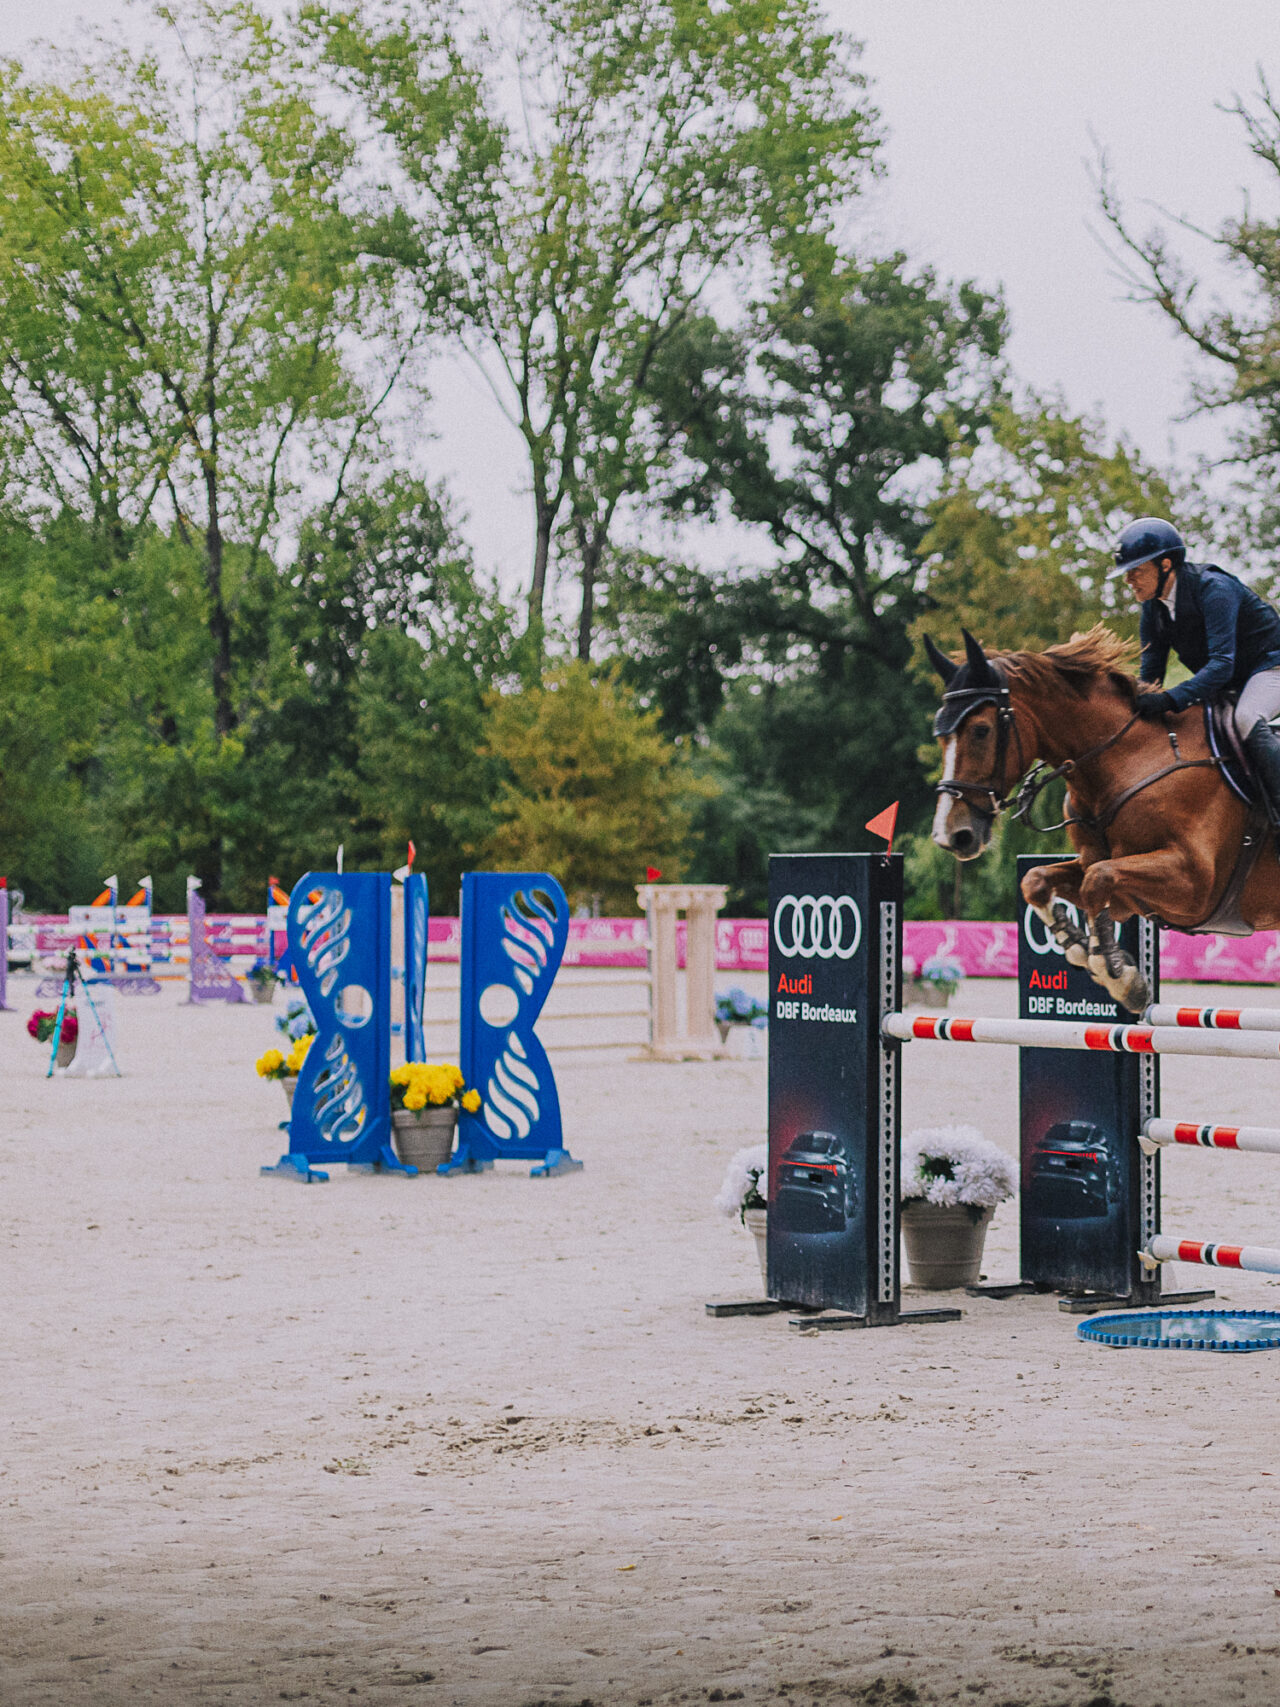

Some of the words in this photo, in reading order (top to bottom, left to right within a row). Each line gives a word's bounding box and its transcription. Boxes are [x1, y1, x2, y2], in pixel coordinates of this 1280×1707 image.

[777, 972, 813, 995] Audi
[1028, 969, 1068, 990] Audi
[776, 1000, 800, 1020] DBF
[801, 1002, 857, 1024] Bordeaux
[1028, 996, 1054, 1014] DBF
[1055, 997, 1118, 1017] Bordeaux
